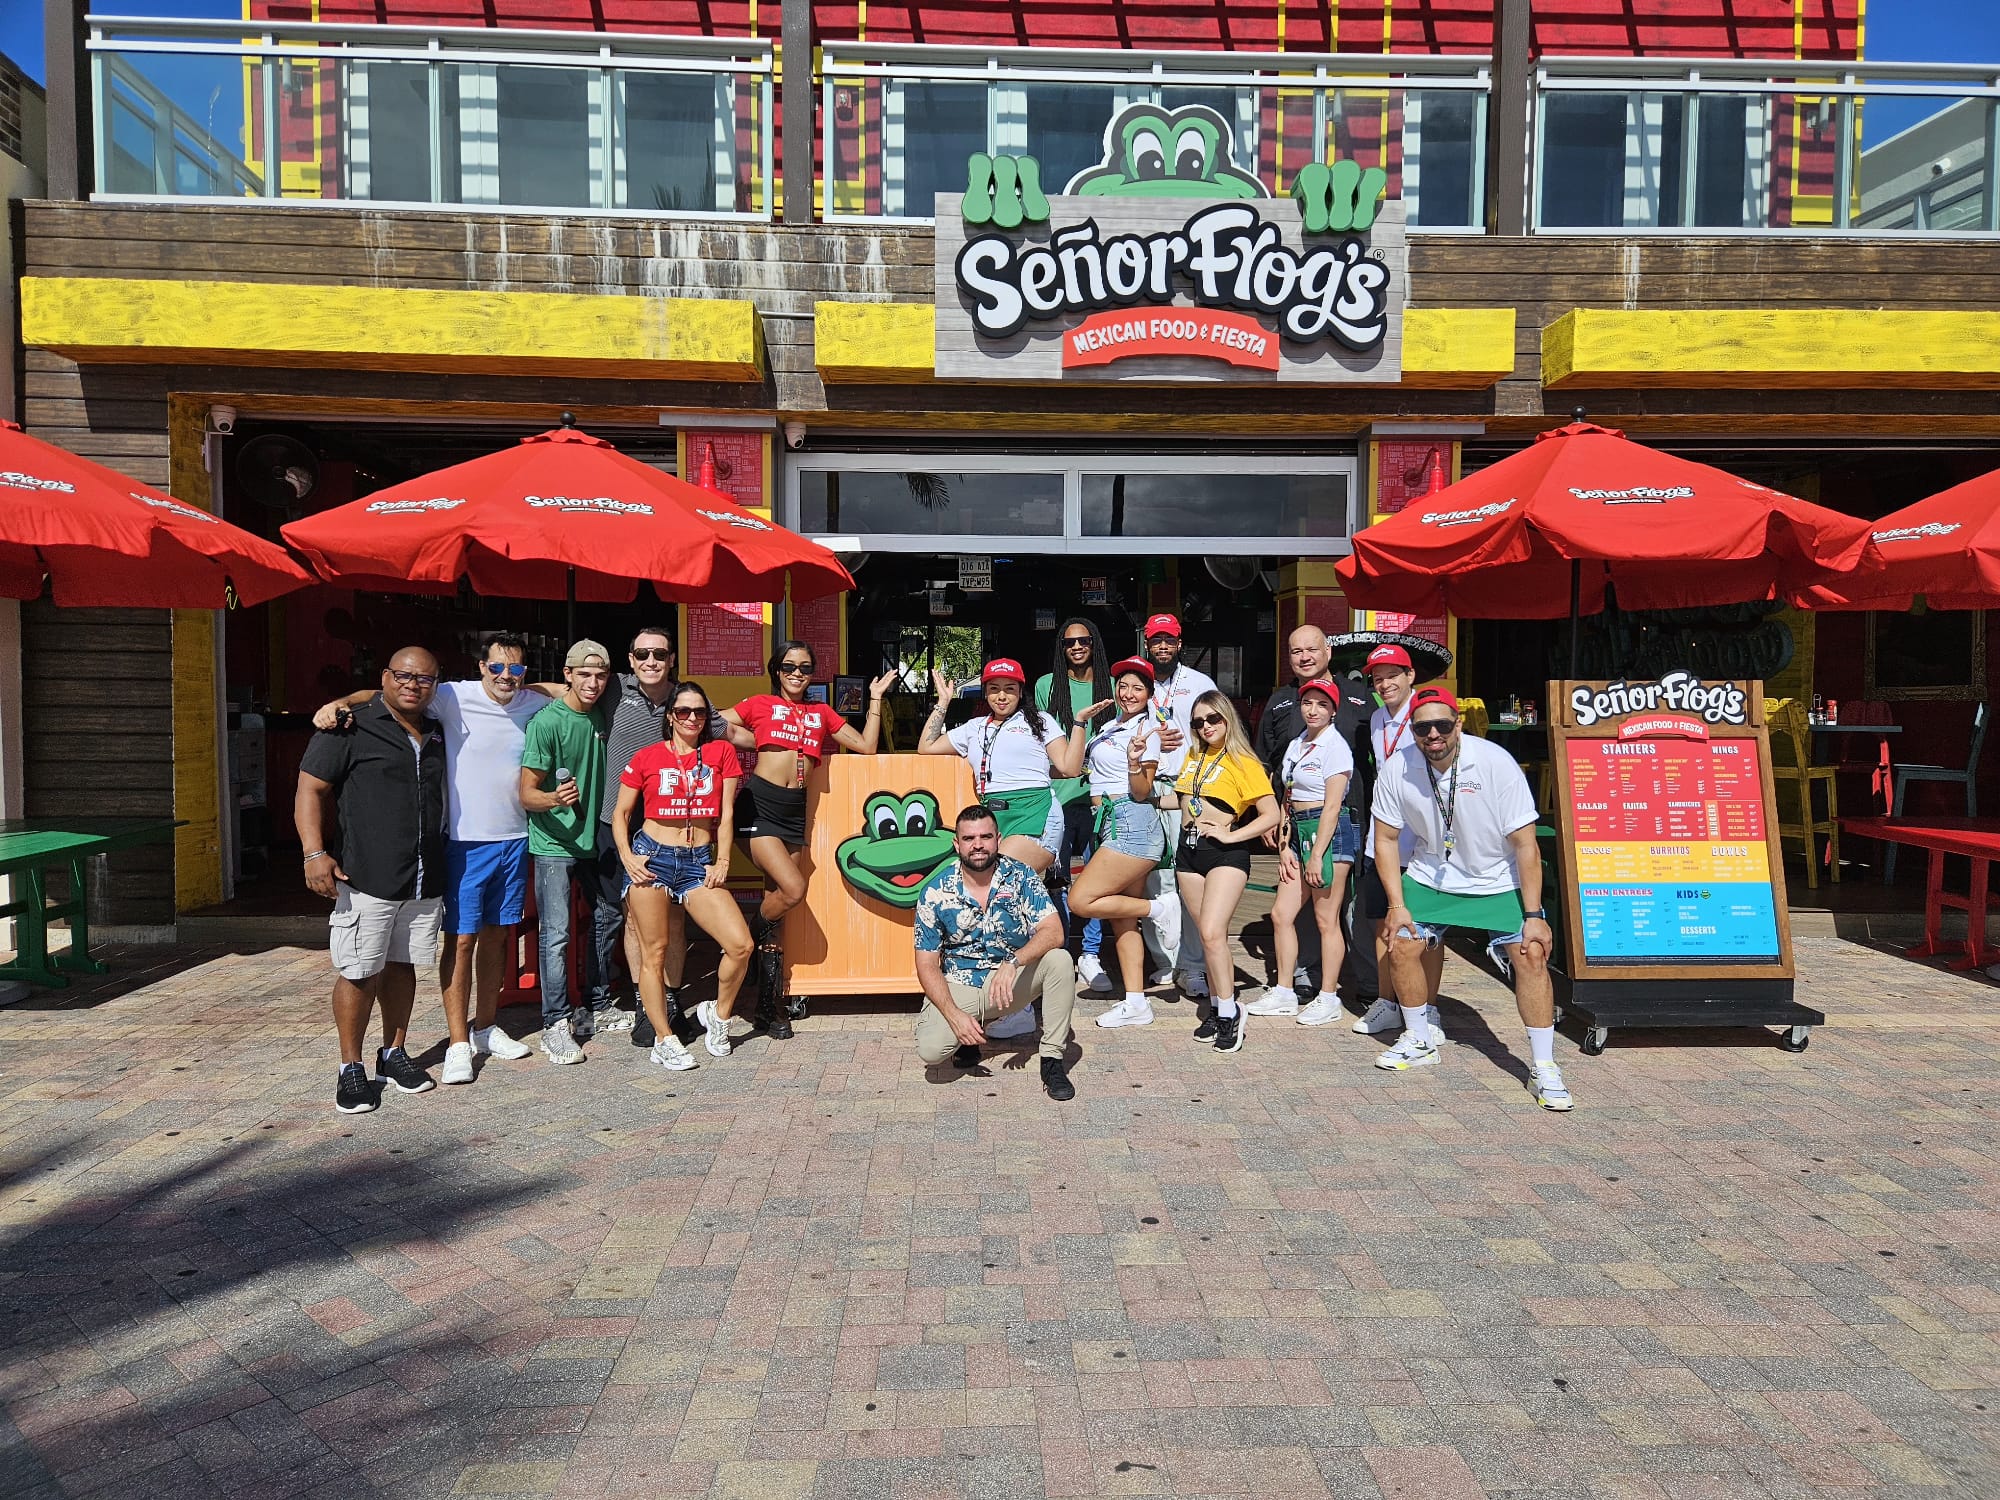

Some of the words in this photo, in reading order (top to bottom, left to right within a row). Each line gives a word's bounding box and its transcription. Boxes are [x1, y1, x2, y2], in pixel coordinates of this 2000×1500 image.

[960, 226, 1189, 329] Señor
[1189, 207, 1386, 344] Frog's
[1072, 319, 1147, 355] MEXICAN
[1150, 318, 1197, 340] FOOD
[1210, 324, 1267, 357] FIESTA
[525, 496, 594, 507] Señor
[593, 497, 655, 514] Frog's
[1571, 683, 1663, 726] Señor
[1662, 672, 1745, 724] Frog's
[1622, 722, 1654, 737] MEXICAN
[1653, 720, 1673, 730] FOOD
[1680, 722, 1705, 735] FIESTA
[1602, 743, 1656, 755] STARTERS
[1711, 745, 1739, 755] WINGS
[1577, 802, 1608, 810] SALADS
[658, 808, 715, 817] UNIVESITY
[1581, 846, 1612, 855] TACOS
[1650, 846, 1690, 856] BURRITOS
[1711, 846, 1748, 857] BOWLS
[1584, 888, 1609, 896] MAIN
[1676, 890, 1699, 899] KIDS
[1680, 926, 1717, 935] DESSERTS
